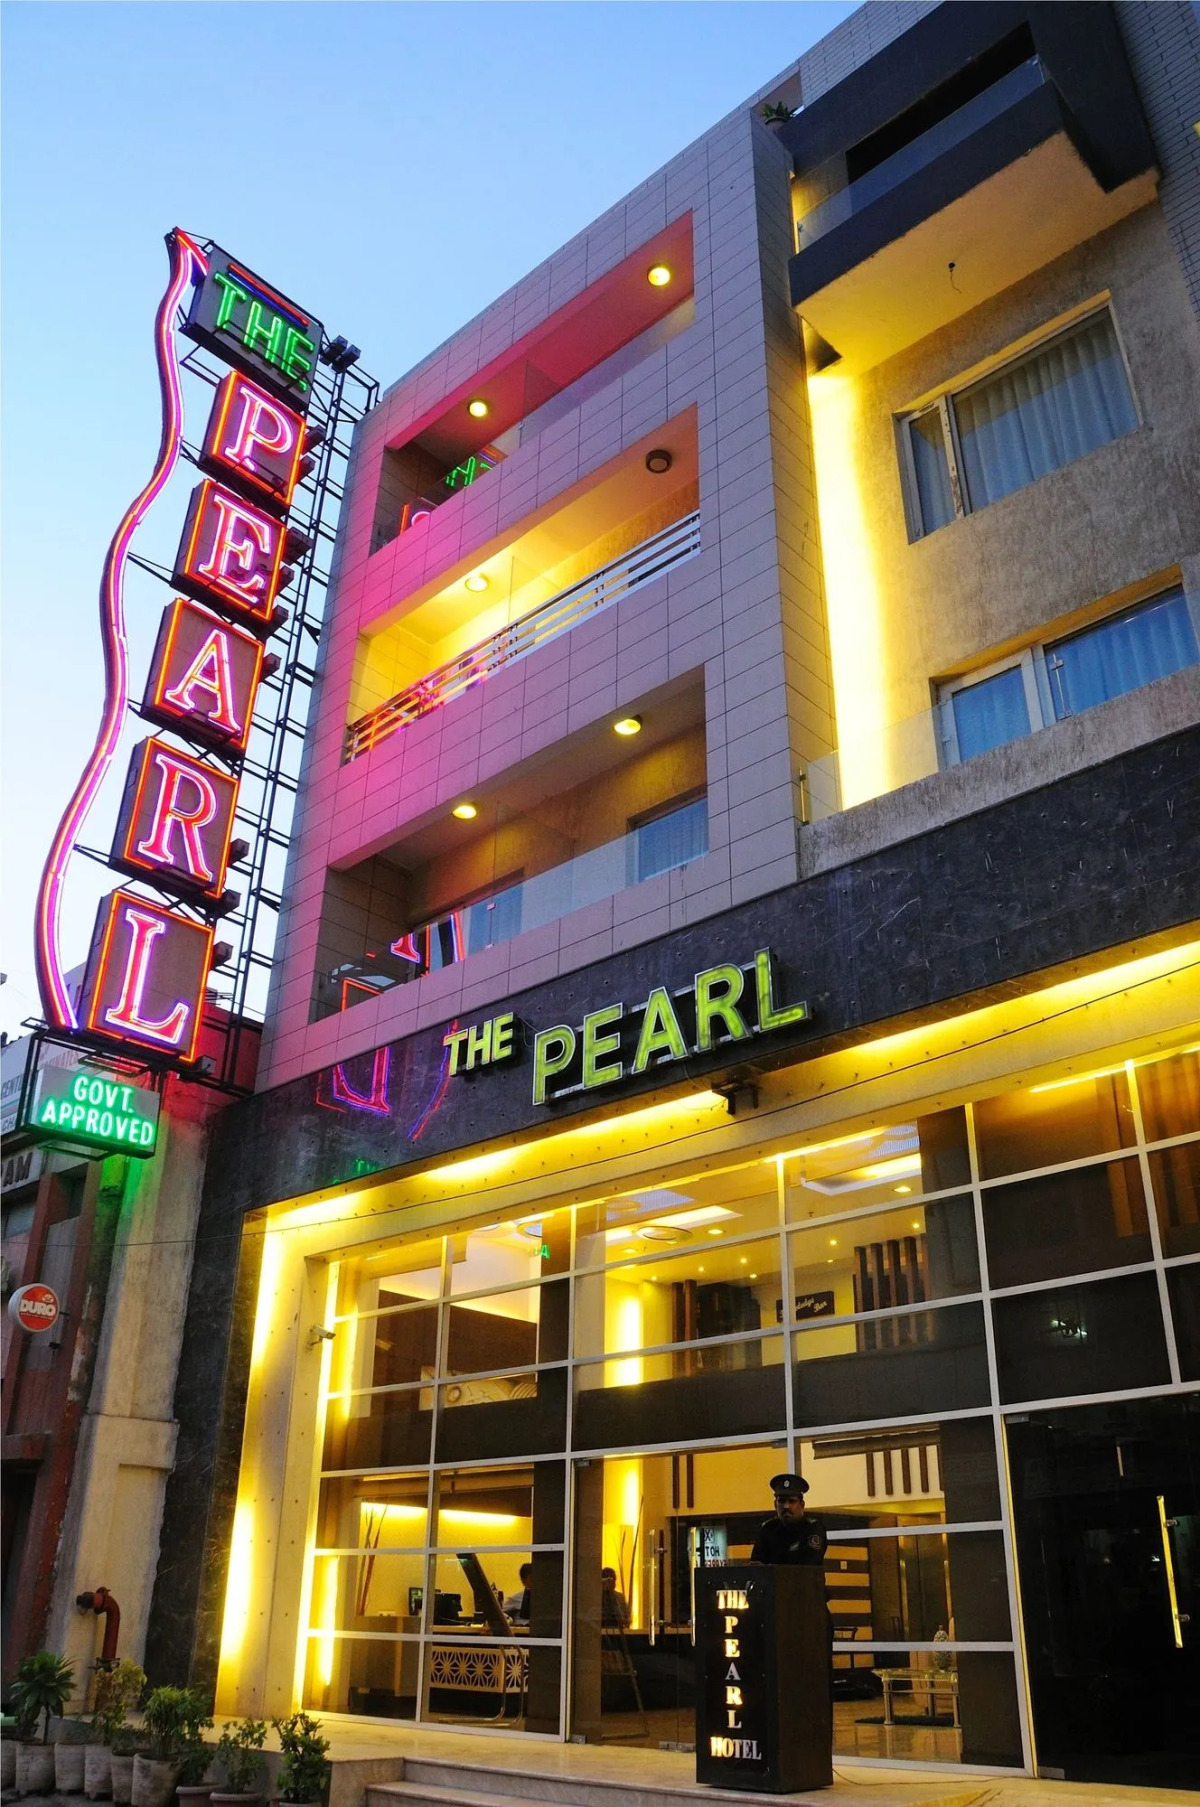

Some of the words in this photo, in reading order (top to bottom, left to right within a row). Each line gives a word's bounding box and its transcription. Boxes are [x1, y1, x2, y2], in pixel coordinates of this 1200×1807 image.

[214, 271, 316, 391] THE
[104, 386, 294, 1046] PEARL
[443, 1011, 515, 1077] THE
[532, 946, 809, 1106] PEARL
[41, 1100, 154, 1146] APPROVED
[1, 1151, 33, 1188] AM
[19, 1299, 57, 1318] DURO
[716, 1589, 749, 1610] THE
[724, 1615, 743, 1730] PEARL
[710, 1736, 763, 1761] HOTEL
